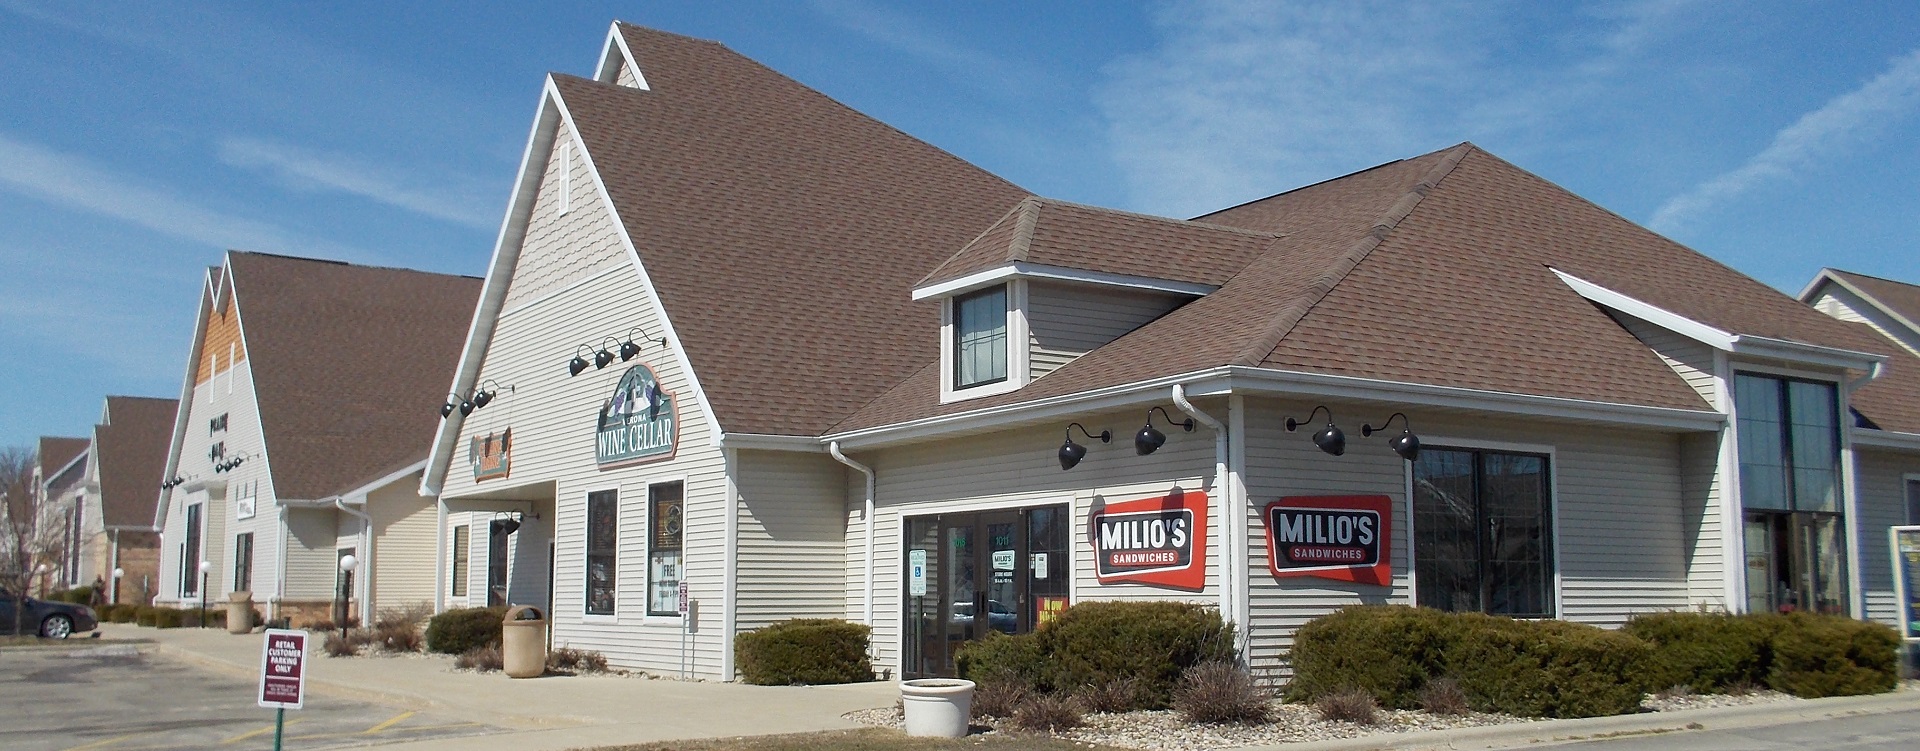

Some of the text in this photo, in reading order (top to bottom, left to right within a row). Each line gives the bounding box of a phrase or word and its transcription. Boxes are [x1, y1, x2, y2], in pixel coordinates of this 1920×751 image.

[598, 418, 673, 458] WINE CELLAR
[1101, 518, 1187, 550] MILIO'S
[1279, 513, 1374, 546] MILIO'S
[1113, 552, 1175, 564] SANDWICHES
[1294, 548, 1362, 560] SANDWICHES
[663, 564, 676, 577] FREE
[1043, 596, 1063, 611] Now
[275, 640, 296, 650] RETAIL
[268, 648, 302, 657] CUSTOMER
[270, 656, 298, 666] PARKING
[274, 664, 292, 673] ONLY
